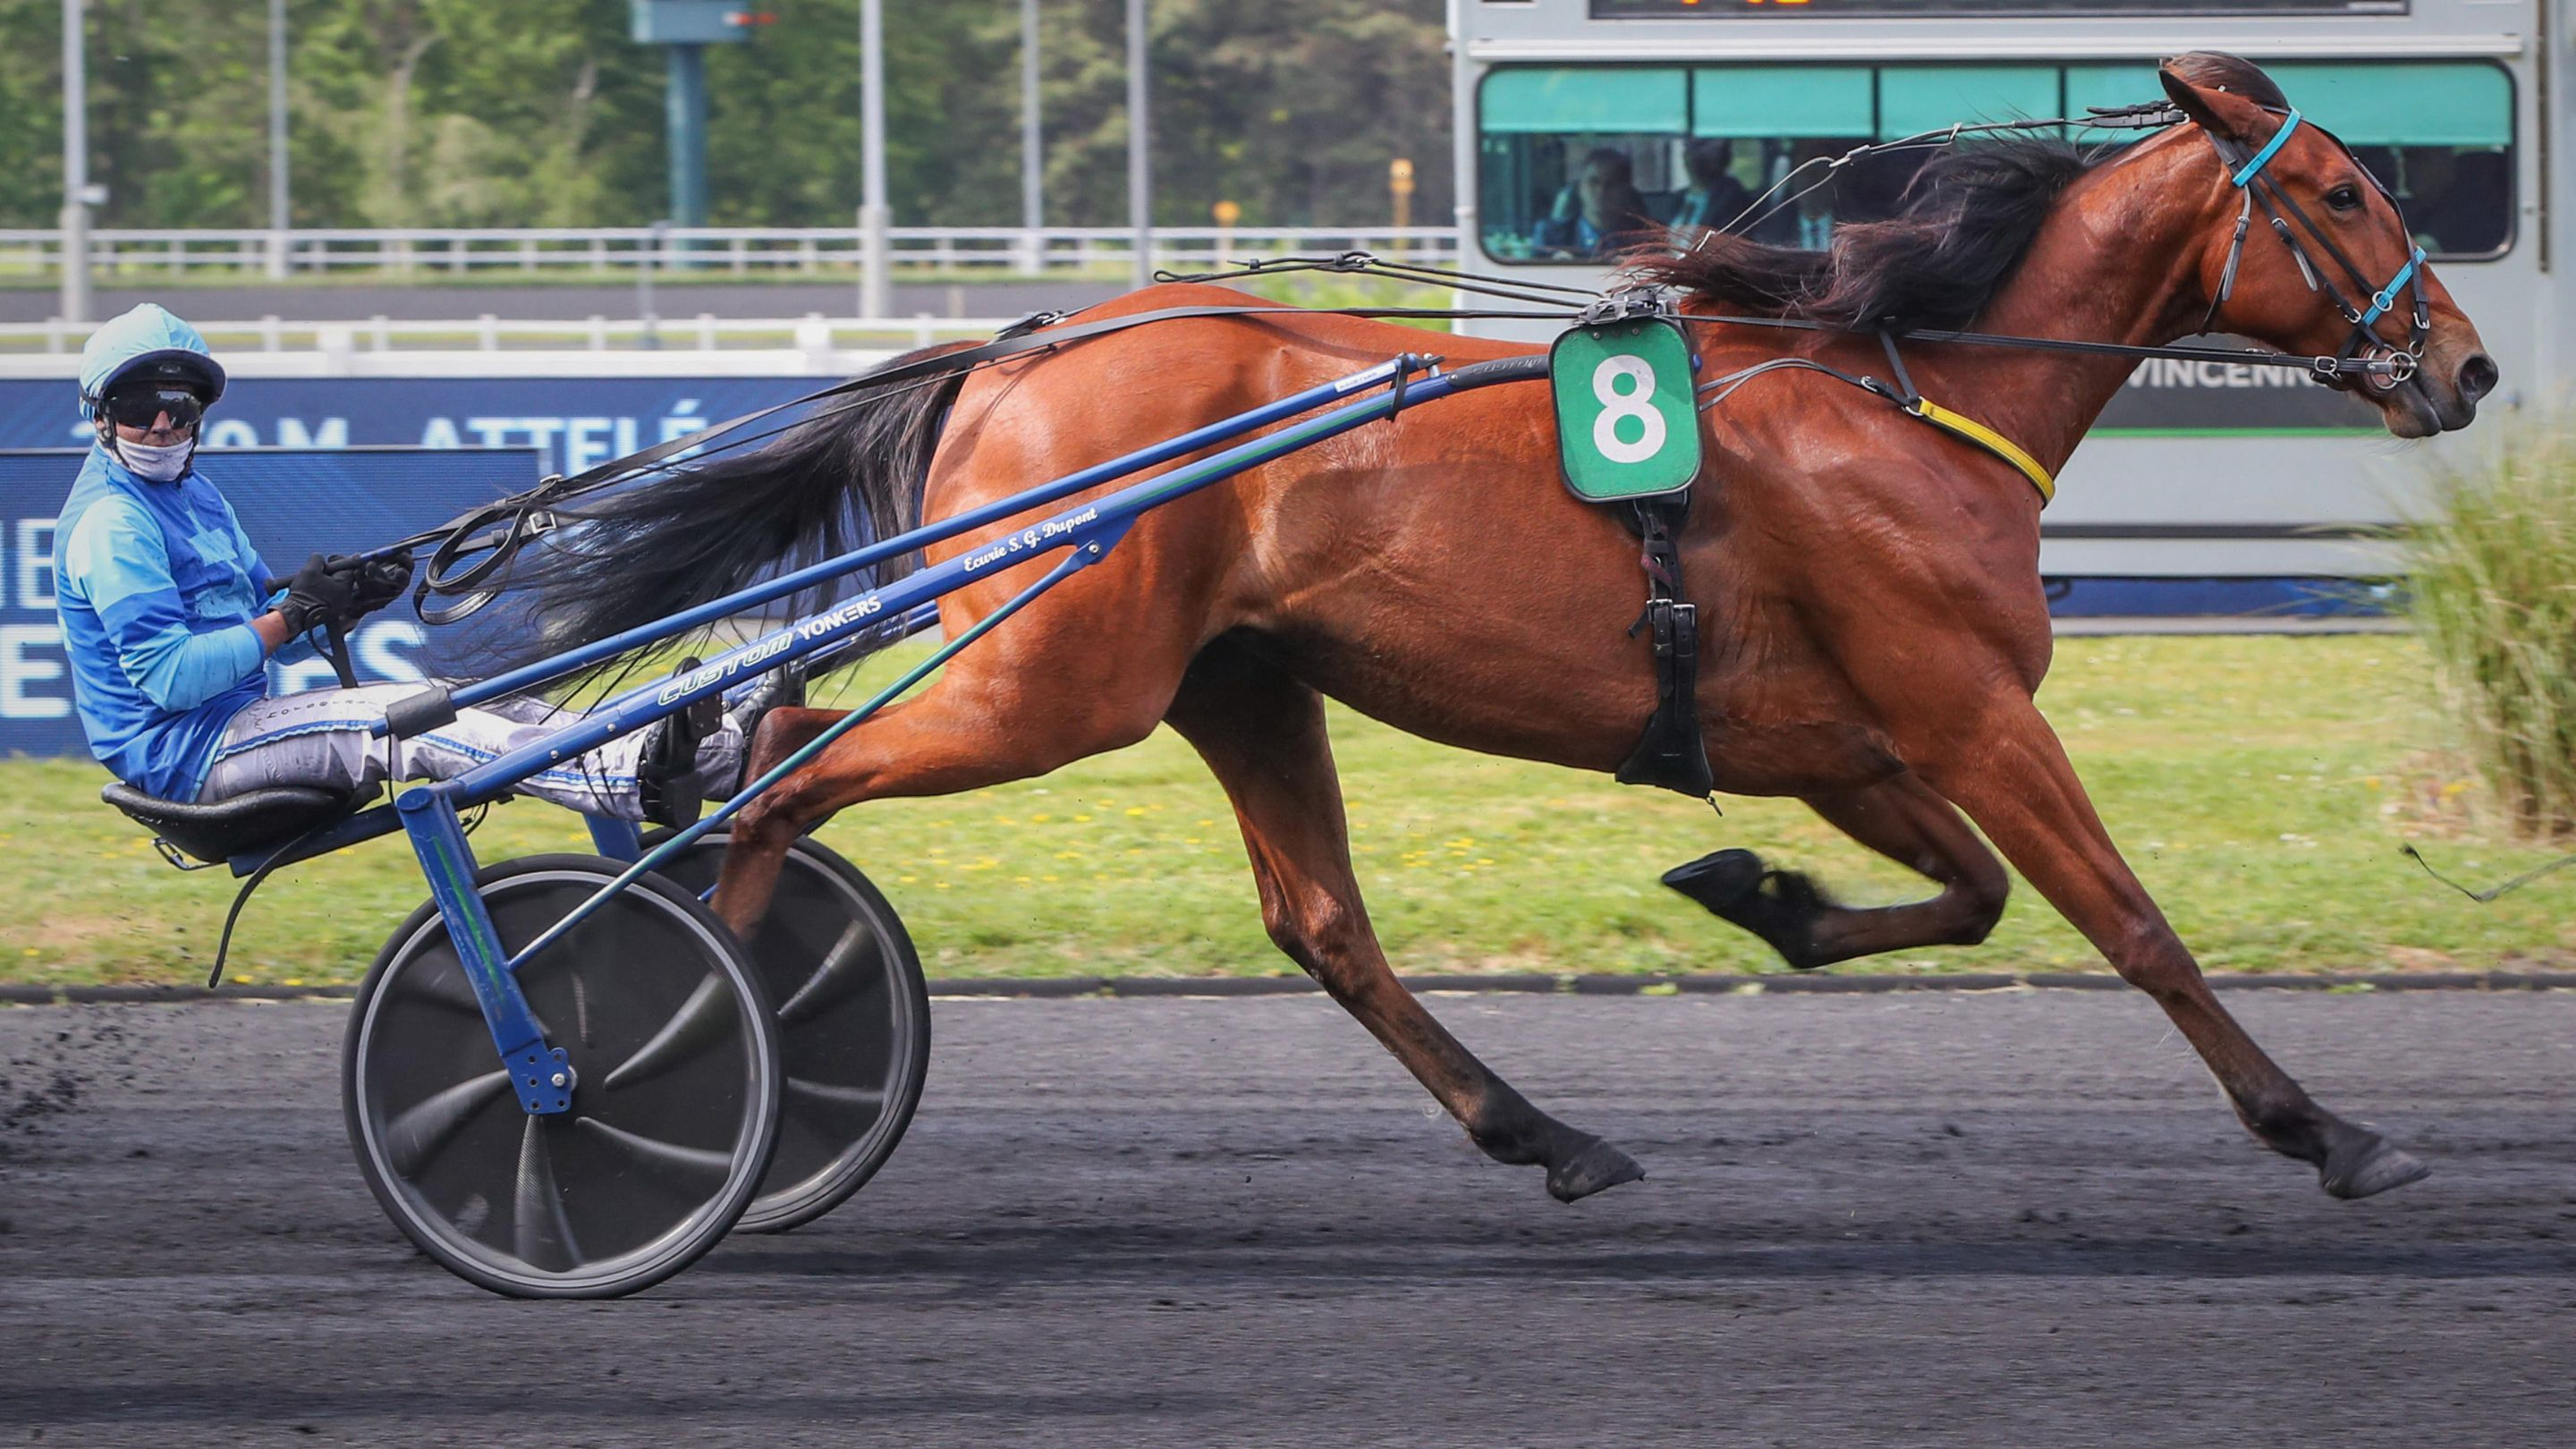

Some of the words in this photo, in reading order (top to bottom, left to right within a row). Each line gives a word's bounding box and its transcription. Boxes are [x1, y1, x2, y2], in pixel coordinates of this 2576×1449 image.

[1592, 354, 1667, 464] 8
[2128, 357, 2328, 388] VINCENN
[963, 546, 1007, 572] Ecurie
[1008, 538, 1022, 553] S.
[1041, 507, 1098, 538] Dupont
[657, 631, 795, 707] CUSTOM
[796, 595, 883, 641] YONKERS
